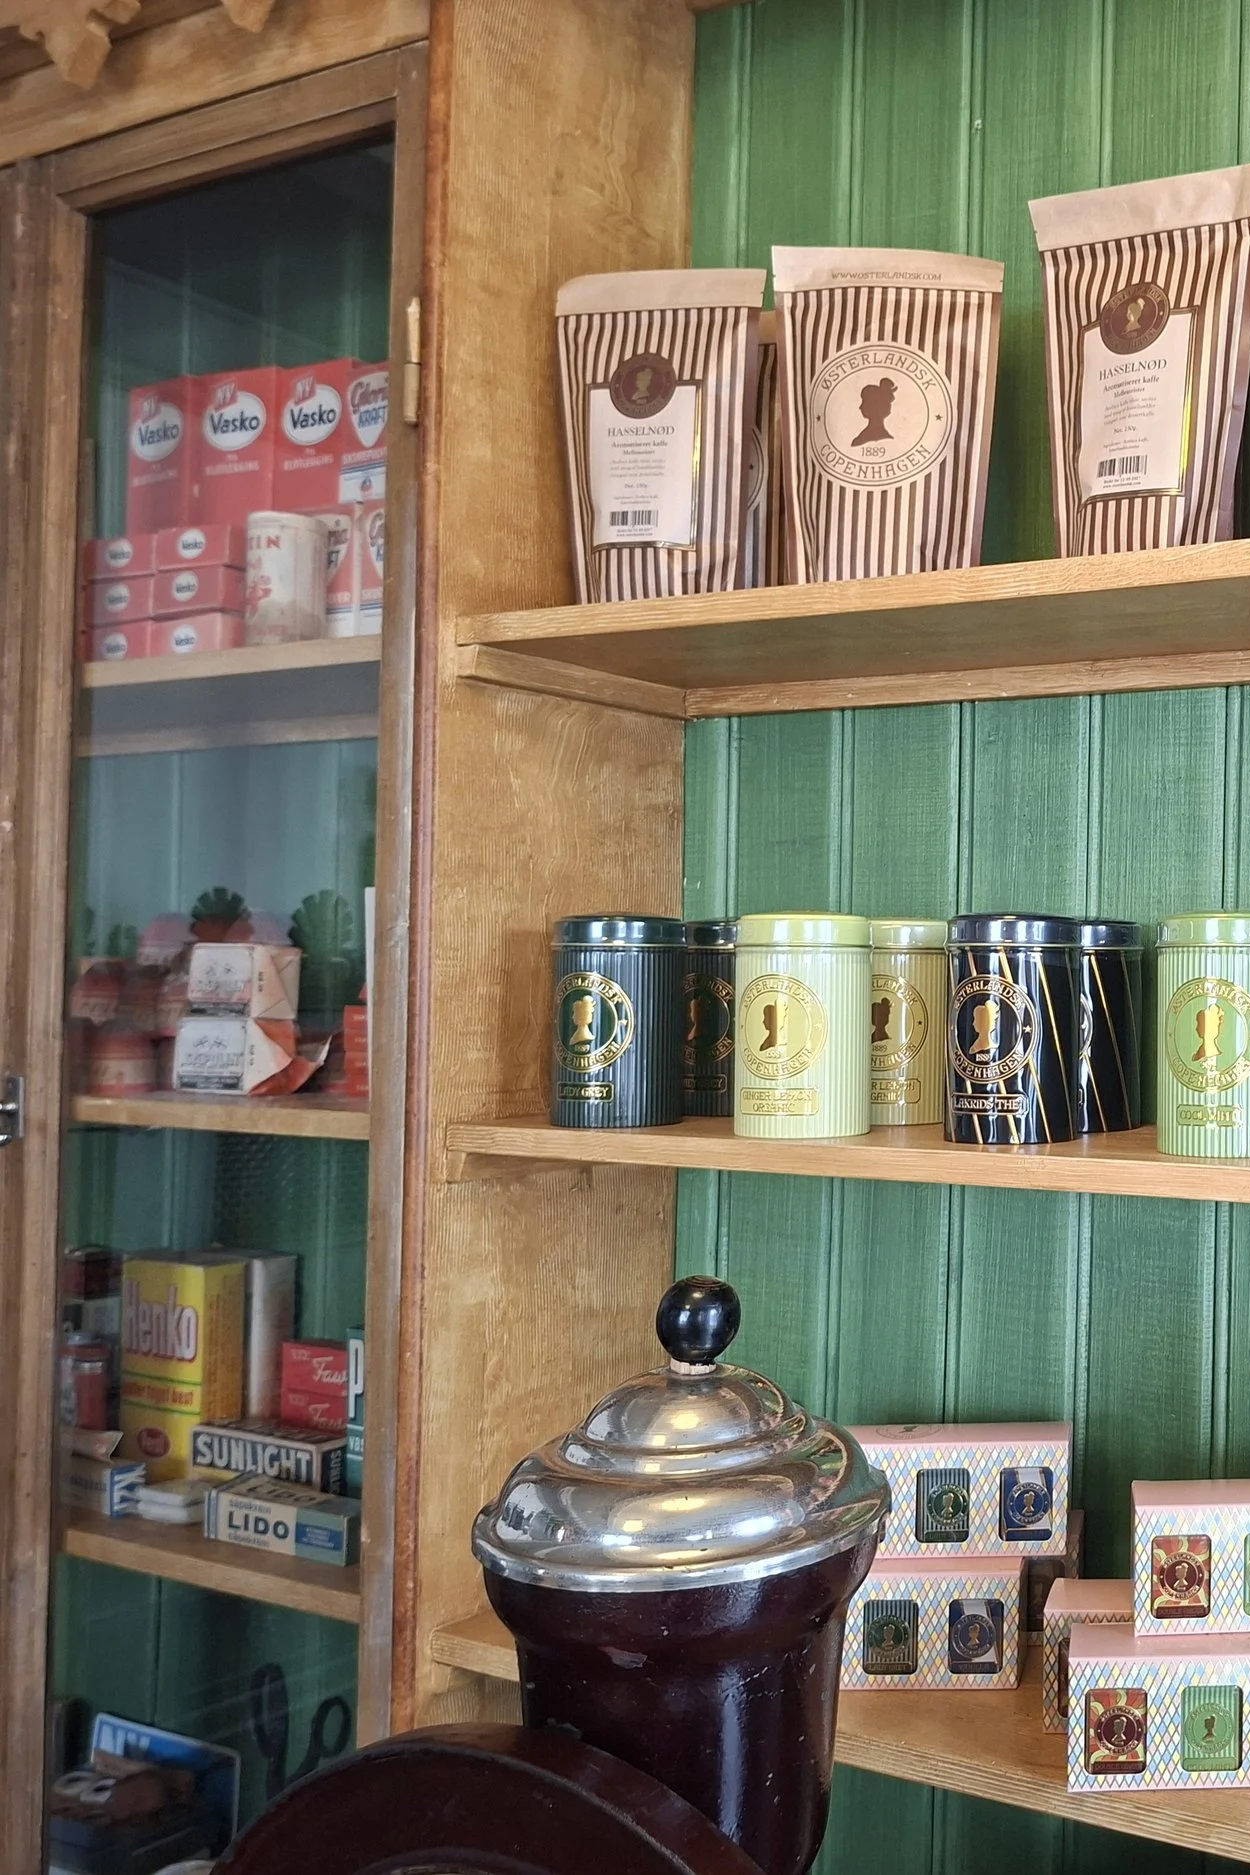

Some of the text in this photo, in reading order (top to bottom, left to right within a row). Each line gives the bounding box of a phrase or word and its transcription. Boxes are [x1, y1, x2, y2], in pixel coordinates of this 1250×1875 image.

[821, 352, 936, 392] ØSTERLANDSK
[1099, 358, 1167, 381] HASSELNØD
[210, 410, 260, 435] Vasko
[290, 404, 337, 430] Vasko
[138, 420, 180, 446] Vasko
[607, 425, 676, 438] HASSELNØD
[820, 443, 931, 480] COPENHAGEN
[861, 446, 886, 457] 1889
[559, 1085, 609, 1098] LADY GREY
[742, 1090, 771, 1101] GINGER
[954, 1097, 993, 1110] LAKRIDS
[124, 1279, 199, 1365] Henko
[196, 1432, 312, 1483] SUNLIGHT
[228, 1509, 290, 1540] LIDO
